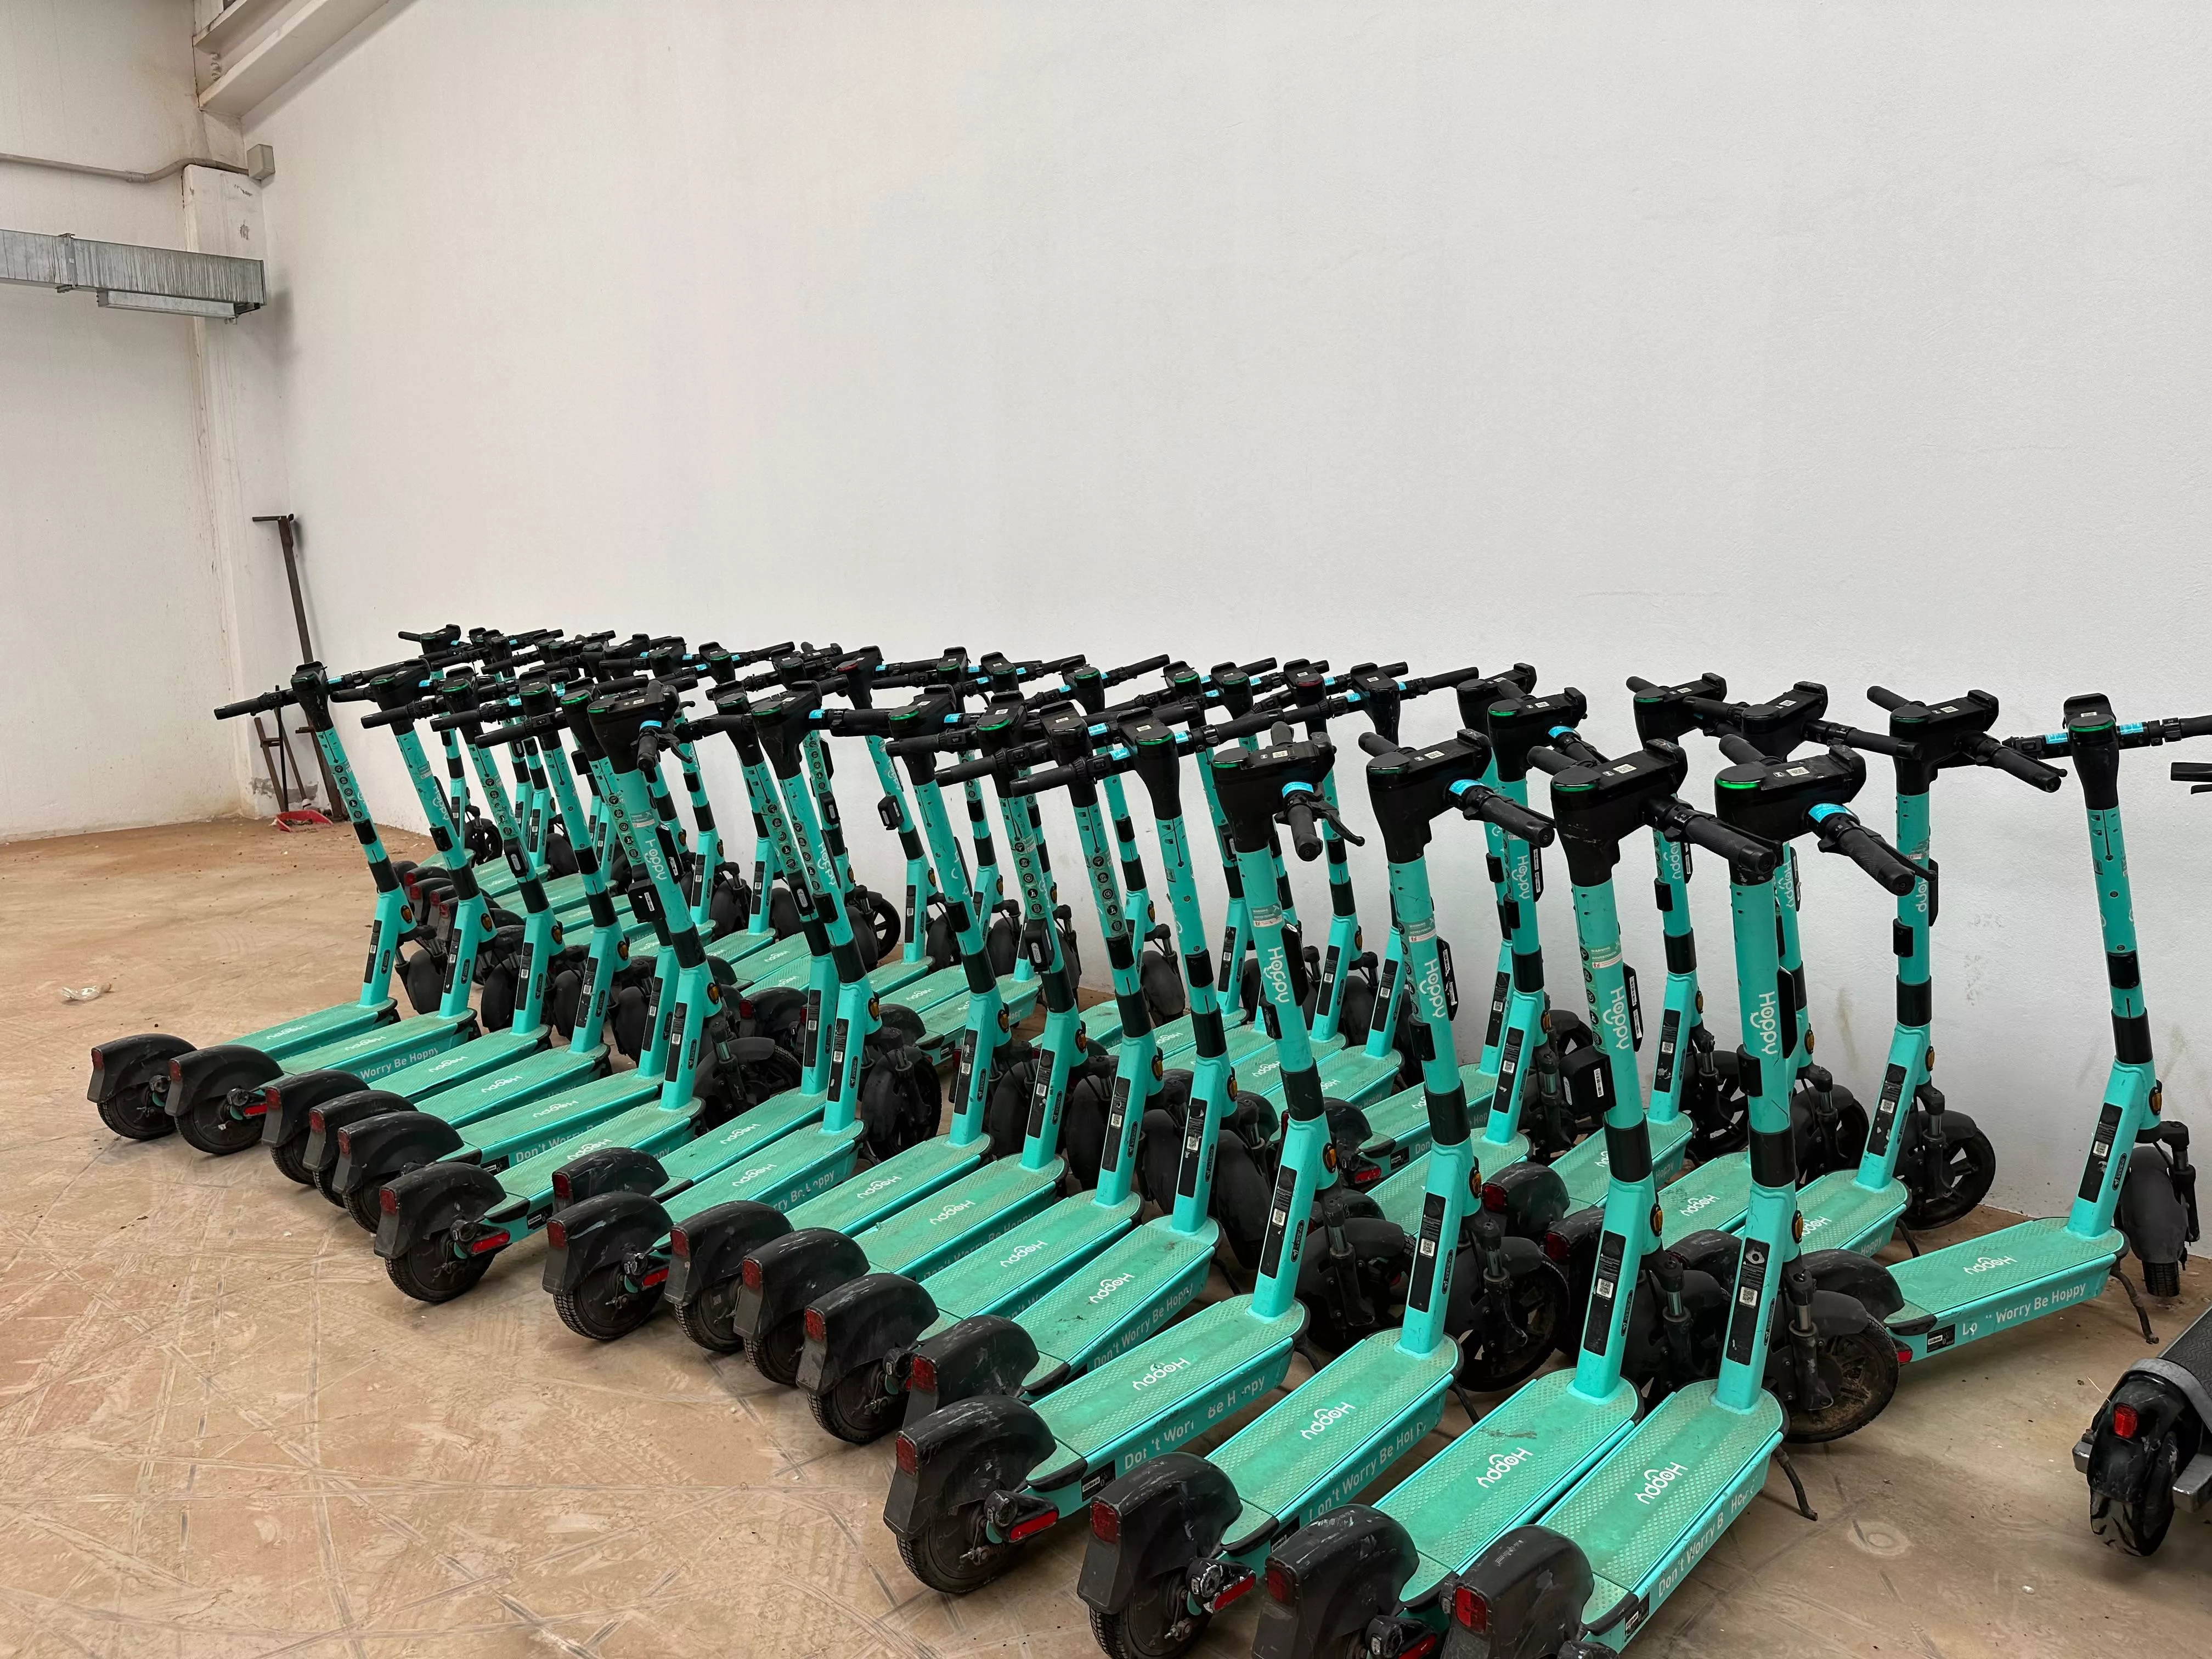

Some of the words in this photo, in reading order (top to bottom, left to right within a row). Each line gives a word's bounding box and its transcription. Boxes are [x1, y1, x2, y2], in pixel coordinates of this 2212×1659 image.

[1511, 855, 1530, 899] Hoppy
[1420, 958, 1446, 1018] Hoppy
[1603, 986, 1629, 1049] Hoppy
[1750, 991, 1778, 1055] Hoppy
[360, 1063, 391, 1080] Worry
[394, 1058, 407, 1068] Be
[428, 1056, 469, 1072] Hoppy
[481, 1075, 523, 1093] Hoppy
[532, 1099, 579, 1118] Hoppy
[1474, 1113, 1487, 1125] Hop
[719, 1123, 761, 1144] Hoppy
[567, 1138, 612, 1160] Hoppy
[1415, 1141, 1430, 1154] Don
[731, 1164, 777, 1187] Hoppy
[857, 1176, 902, 1199] Hoppy
[929, 1200, 975, 1224] Hoppy
[1680, 1195, 1720, 1216] Hoppy
[1000, 1240, 1047, 1268] Hoppy
[1861, 1235, 1883, 1255] Hoppy
[1963, 1256, 2017, 1275] Hoppy
[1088, 1272, 1135, 1304] Hoppy
[1996, 1300, 2030, 1323] Worry
[2034, 1296, 2049, 1310] Be
[2051, 1282, 2086, 1304] Hoppy
[1094, 1340, 1120, 1369] Don't
[1121, 1322, 1150, 1349] Worry
[1153, 1306, 1164, 1323] Be
[1132, 1357, 1190, 1391] Hoppy
[1300, 1401, 1356, 1440] Hoppy
[1342, 1459, 1377, 1494] Worry
[1380, 1446, 1393, 1465] Be
[1476, 1447, 1534, 1488] Hoppy
[1634, 1461, 1689, 1504] Hoppy
[1658, 1559, 1684, 1598] Don't
[1687, 1525, 1714, 1565] Worry
[1717, 1513, 1724, 1530] B
